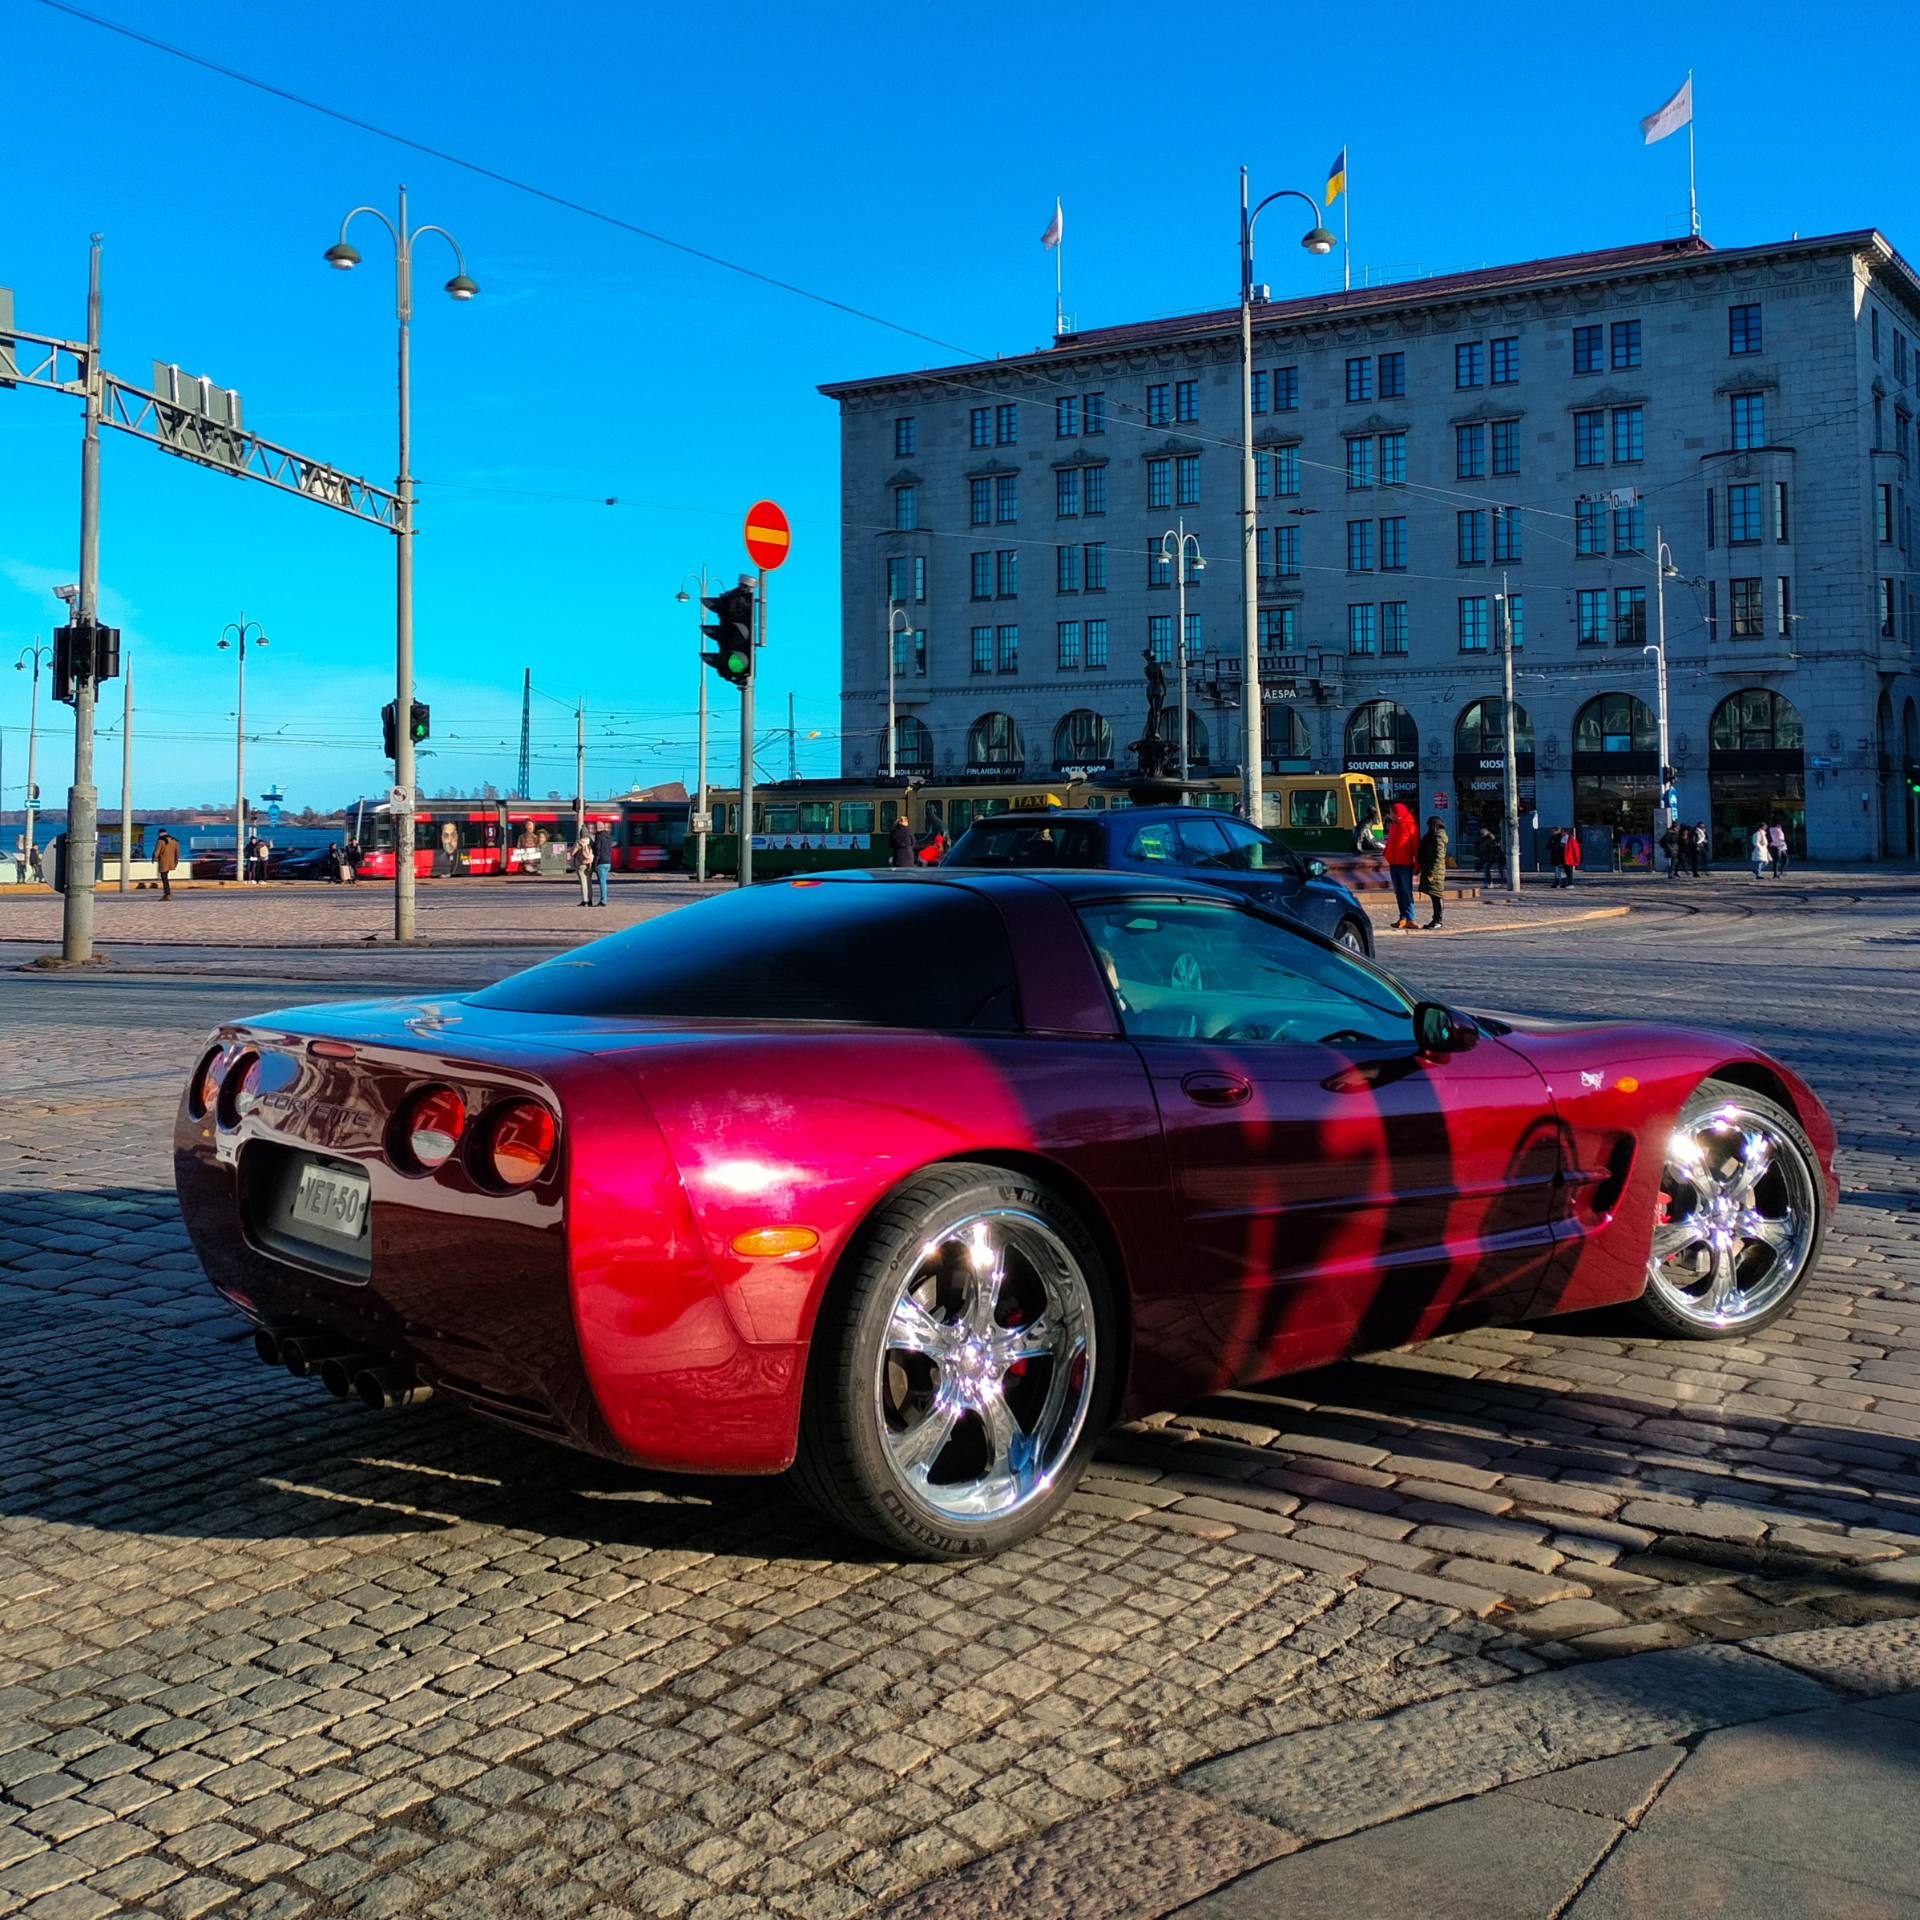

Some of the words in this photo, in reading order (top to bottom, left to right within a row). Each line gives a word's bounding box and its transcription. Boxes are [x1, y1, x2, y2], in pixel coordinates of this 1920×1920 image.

[1086, 765, 1106, 773] SHOP
[1347, 761, 1390, 770] SOUVENIR
[1391, 761, 1415, 770] SHOP
[966, 767, 1000, 776] FINLANDIA
[1393, 782, 1417, 791] SHOP
[1470, 781, 1498, 791] KIOSK
[1017, 796, 1046, 807] TAXI
[262, 1092, 373, 1127] CORVETTE
[884, 1494, 964, 1553] MICHELIN
